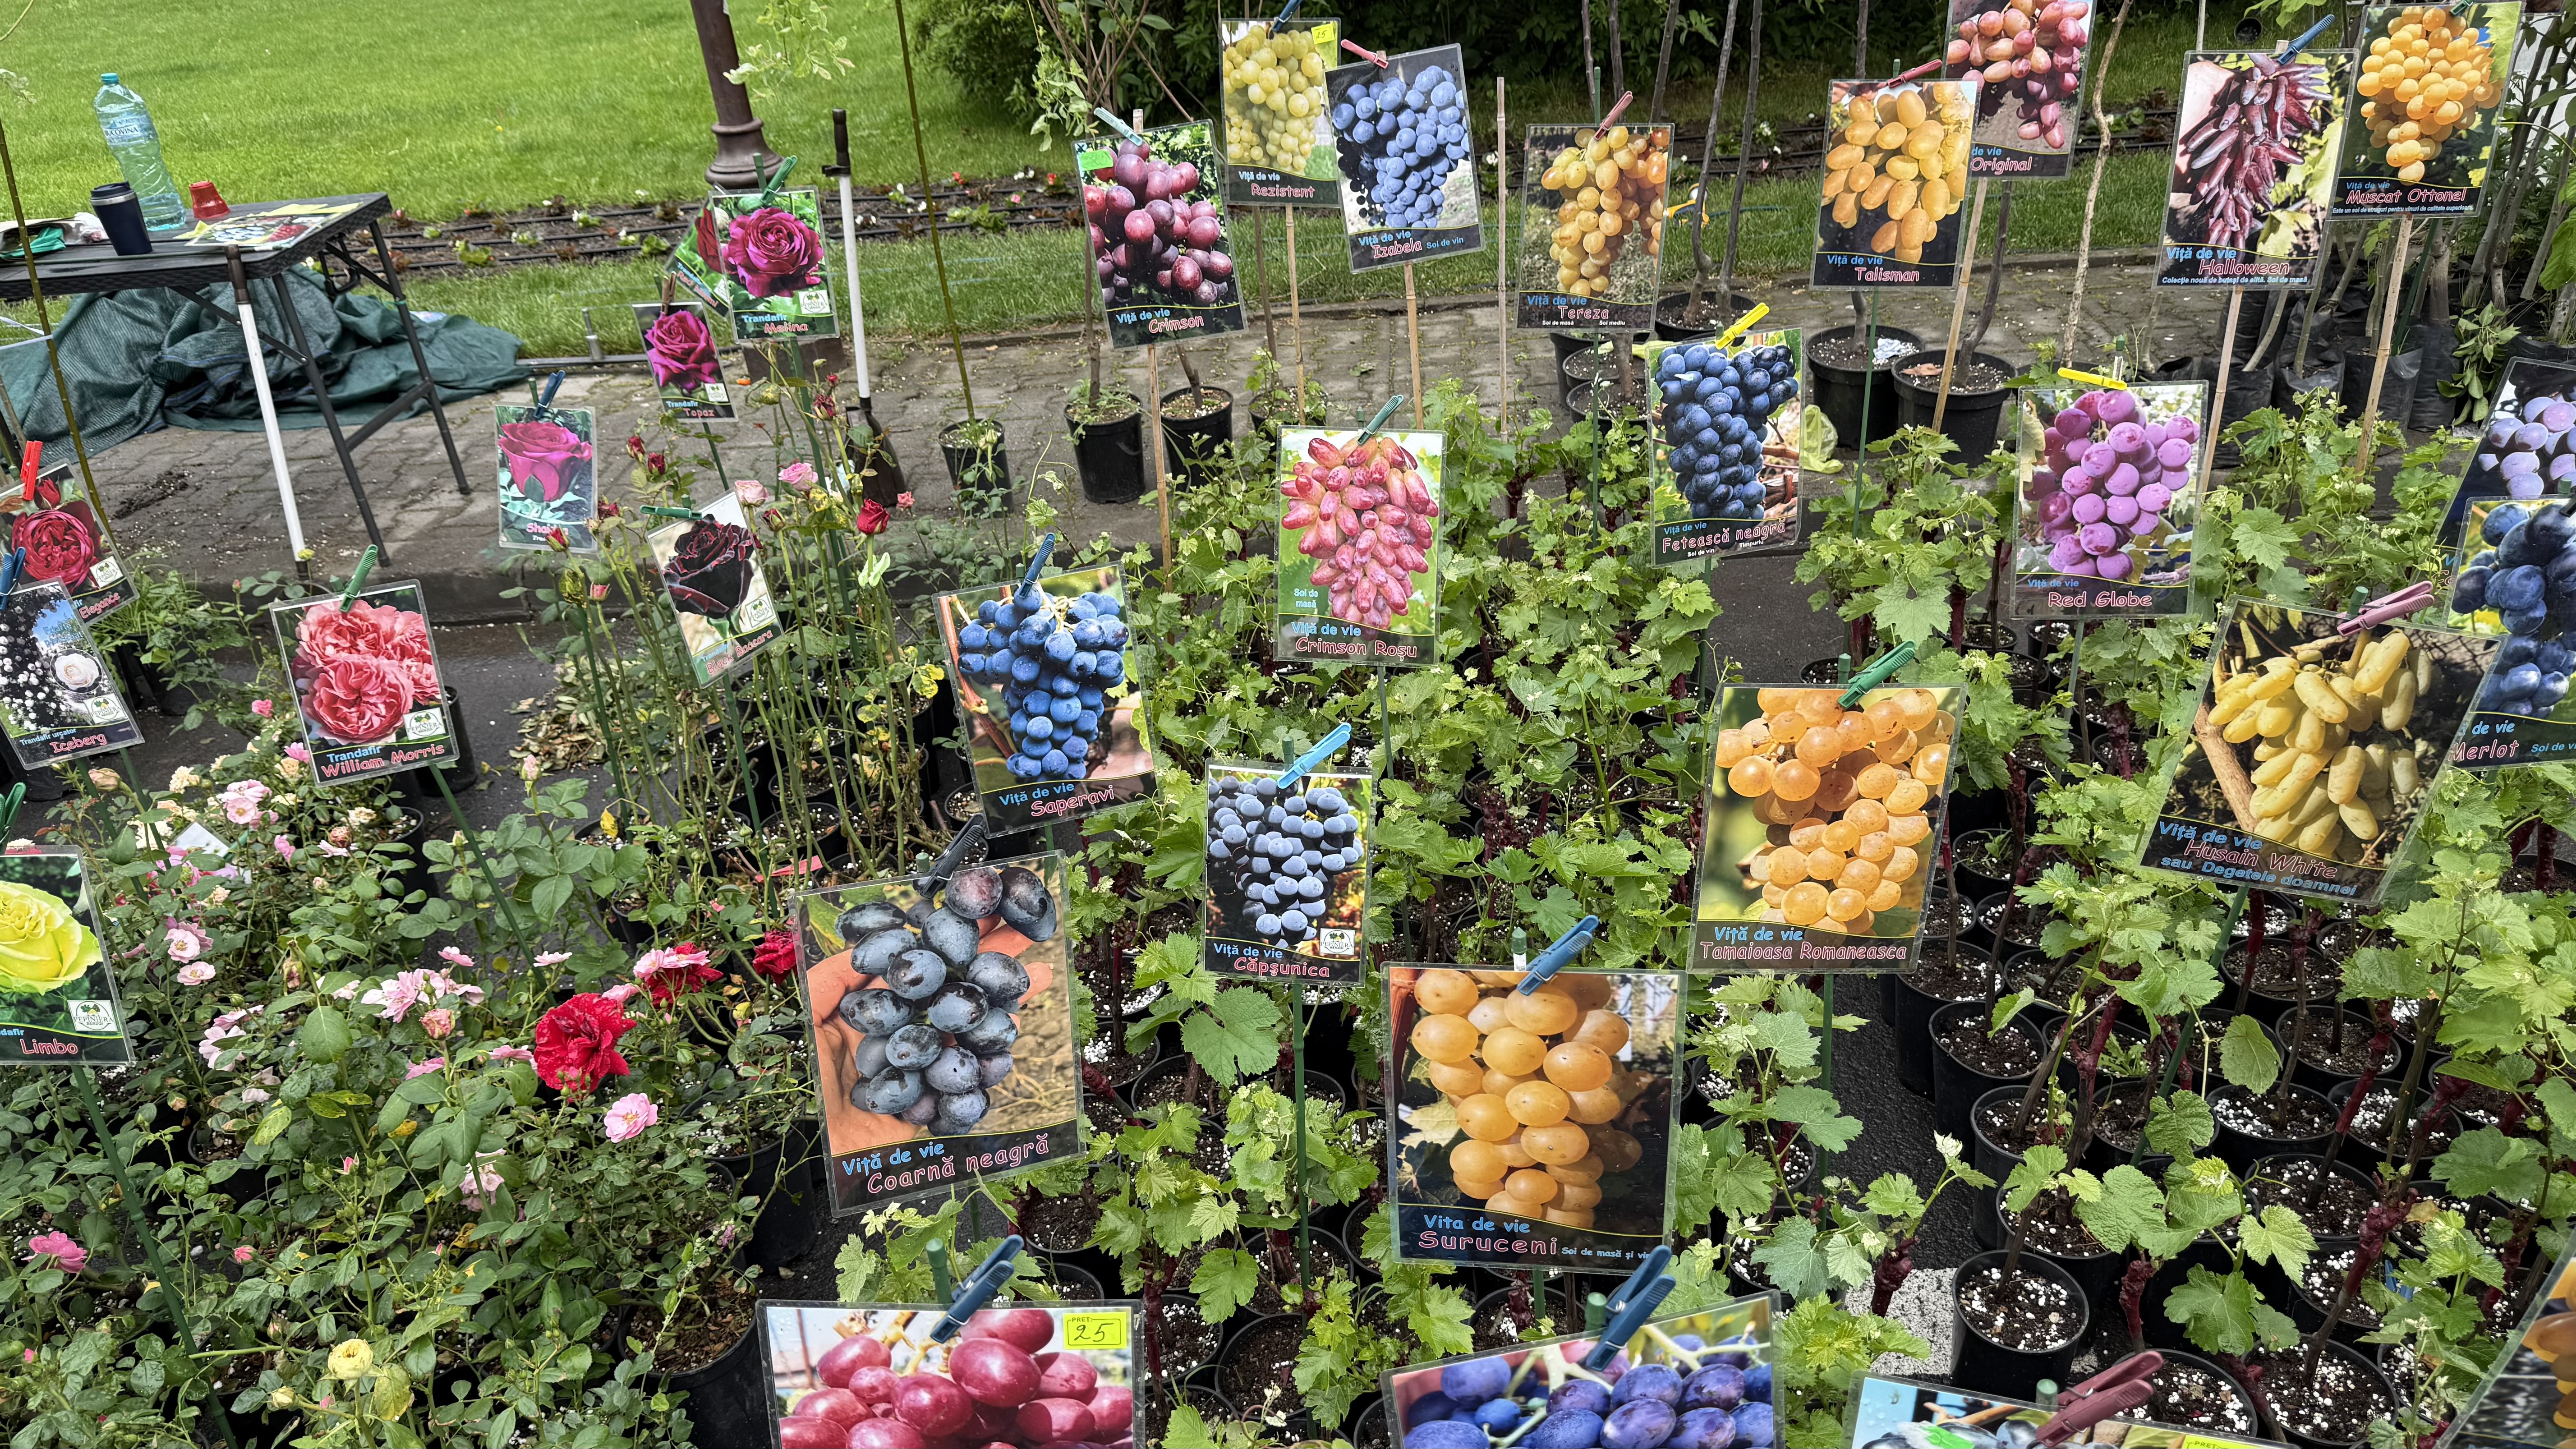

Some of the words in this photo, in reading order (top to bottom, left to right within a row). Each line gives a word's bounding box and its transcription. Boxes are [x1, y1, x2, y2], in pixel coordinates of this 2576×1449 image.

[1972, 147, 1983, 156] de
[1987, 147, 2002, 156] vie
[1971, 156, 2033, 175] Original
[1256, 172, 1266, 180] de
[1268, 172, 1280, 181] vie
[1251, 183, 1315, 198] Rezistent
[2346, 189, 2402, 204] Muscat
[2407, 187, 2467, 202] Ottonel
[1381, 233, 1394, 243] de
[1395, 230, 1411, 239] vie
[1372, 238, 1422, 258] Izabela
[2196, 247, 2213, 259] de
[2217, 247, 2236, 259] vie
[1851, 255, 1864, 265] de
[1867, 256, 1883, 265] vie
[2198, 258, 2290, 275] Halloween
[1854, 266, 1919, 282] Talisman
[1553, 295, 1567, 305] de
[1570, 295, 1587, 305] vie
[742, 313, 787, 323] Trandafir
[1140, 311, 1152, 321] de
[1155, 308, 1170, 318] vie
[1558, 305, 1610, 319] Tereza
[764, 322, 808, 334] Melina
[1149, 316, 1205, 334] Crimson
[683, 408, 715, 419] Topaz
[526, 522, 569, 535] Shaka
[1682, 524, 1693, 532] de
[1694, 521, 1707, 530] vie
[1662, 527, 1730, 554] Fetească
[1736, 518, 1785, 541] neagră
[1739, 539, 1764, 548] Timpuriu
[2049, 579, 2062, 587] de
[1294, 588, 1307, 597] Soi
[1308, 589, 1318, 598] de
[2048, 591, 2087, 608] Red
[2095, 591, 2152, 607] Globe
[79, 592, 120, 619] Elegance
[1321, 624, 1338, 635] de
[1341, 625, 1362, 636] vie
[706, 653, 734, 675] Black
[735, 630, 773, 658] Baccara
[1295, 636, 1367, 655] Crimson
[2472, 721, 2489, 735] de
[2496, 720, 2515, 733] vie
[19, 732, 51, 746] Trandafir
[50, 734, 107, 754] Iceberg
[327, 745, 382, 763] Trandafir
[2447, 739, 2519, 761] Merlot
[2531, 743, 2549, 753] Soi
[2552, 742, 2565, 751] de
[321, 756, 384, 778] William
[391, 744, 445, 764] Morris
[1032, 787, 1050, 799] de
[1053, 782, 1075, 795] vie
[1031, 785, 1114, 817] Saperavi
[2202, 830, 2227, 844] de
[2233, 835, 2263, 850] vie
[2183, 839, 2259, 867] Husain
[2270, 852, 2337, 879] White
[2160, 856, 2191, 870] sau
[2201, 861, 2276, 883] Degetele
[2281, 875, 2358, 896] doamnei
[1753, 926, 1773, 941] de
[1780, 926, 1803, 942] vie
[1243, 947, 1260, 957] de
[1263, 948, 1283, 959] vie
[1700, 941, 1793, 960] Tamaioasa
[1799, 941, 1907, 960] Romaneasca
[0, 1028, 24, 1036] dafir
[20, 1038, 78, 1055] Limbo
[889, 1148, 912, 1166] de
[919, 1141, 945, 1159] vie
[867, 1155, 955, 1194] Coarnă
[966, 1133, 1049, 1172] neagră
[1424, 1214, 1464, 1231] Vita
[1472, 1216, 1495, 1232] de
[1503, 1219, 1531, 1233] vie
[1418, 1231, 1557, 1255] Suruceni
[1561, 1247, 1577, 1255] Soi
[1581, 1247, 1593, 1256] de
[1596, 1250, 1622, 1258] masă
[1074, 1322, 1114, 1342] 25
